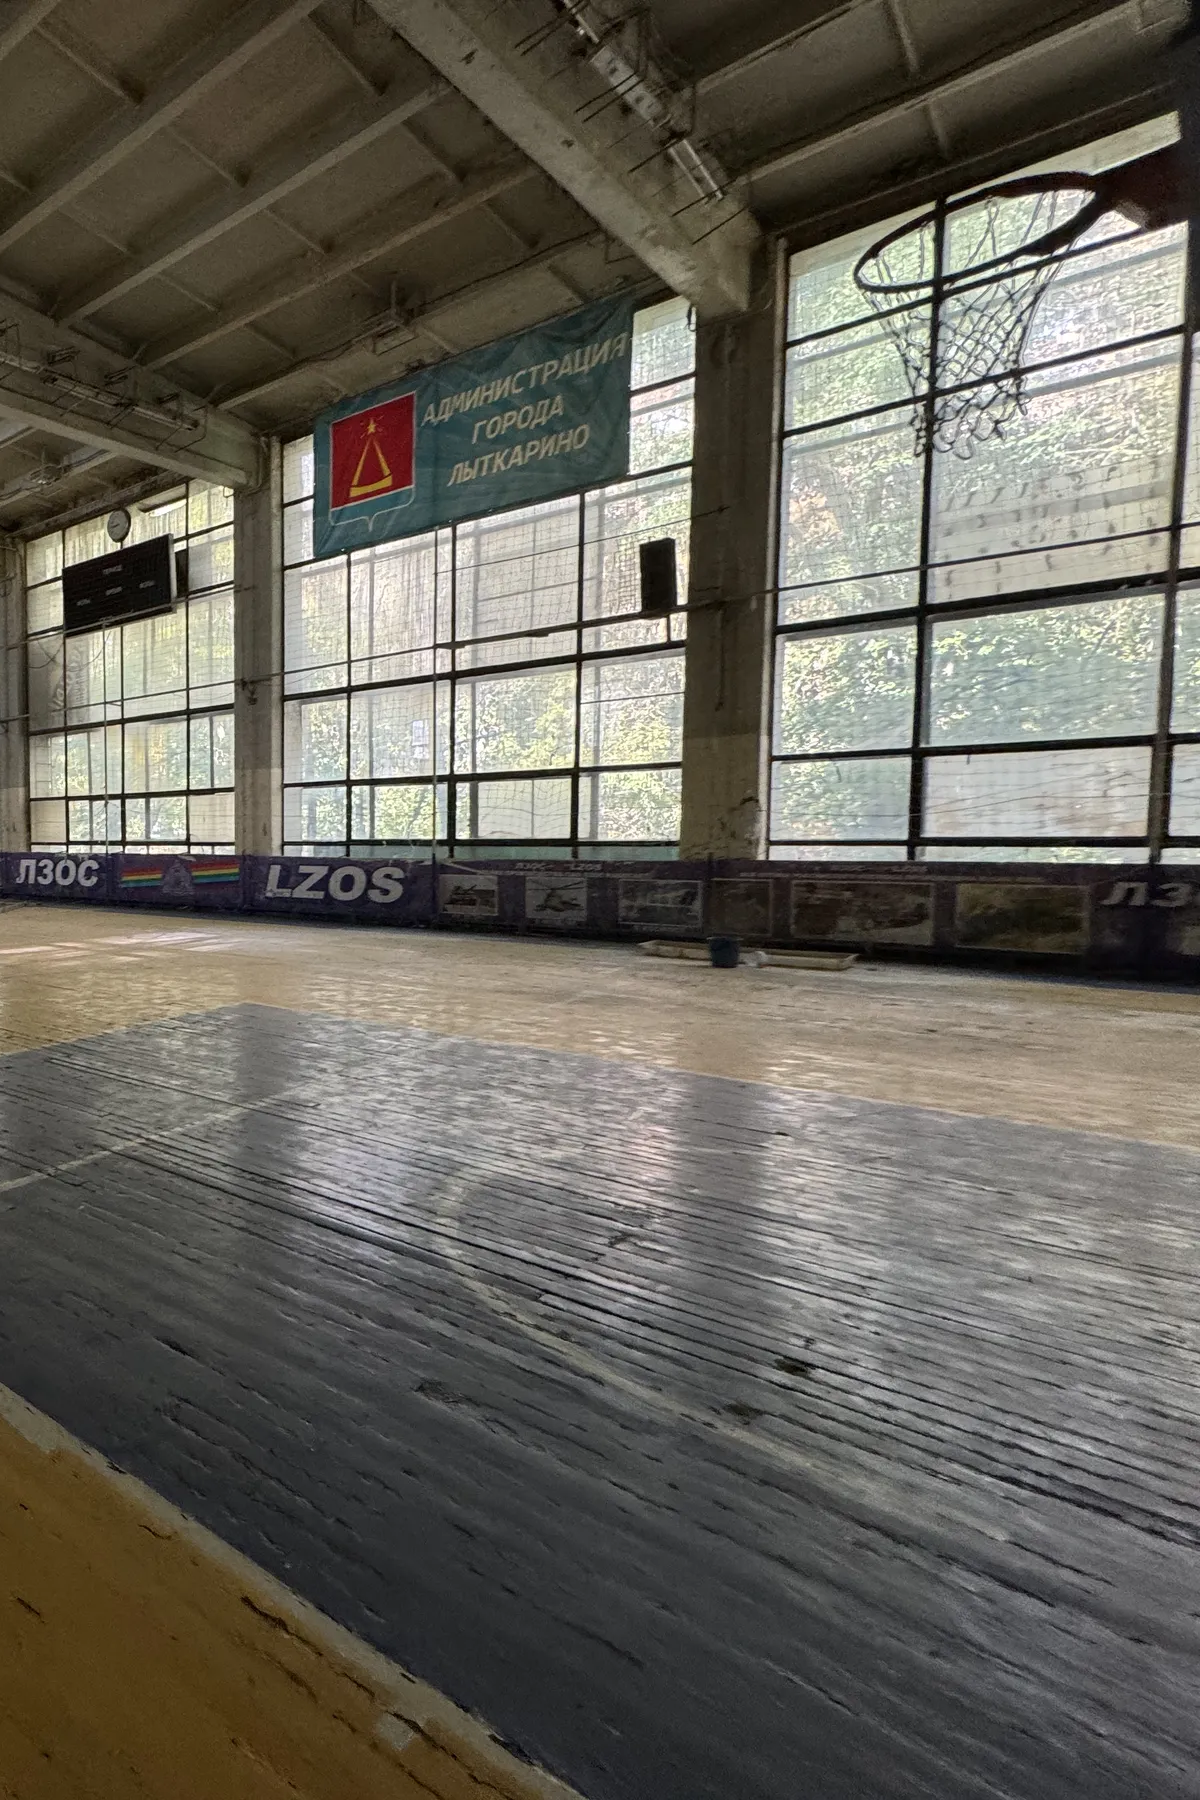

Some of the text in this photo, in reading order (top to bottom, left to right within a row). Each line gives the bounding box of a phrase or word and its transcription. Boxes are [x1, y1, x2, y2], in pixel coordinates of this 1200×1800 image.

[420, 332, 630, 427] АДМИНИСТРАЦИЯ
[471, 395, 564, 445] ГОРОДА
[446, 424, 590, 488] ЛЫТКАРИНО
[15, 858, 99, 887] ЛЗОС
[264, 864, 405, 903] LZOS
